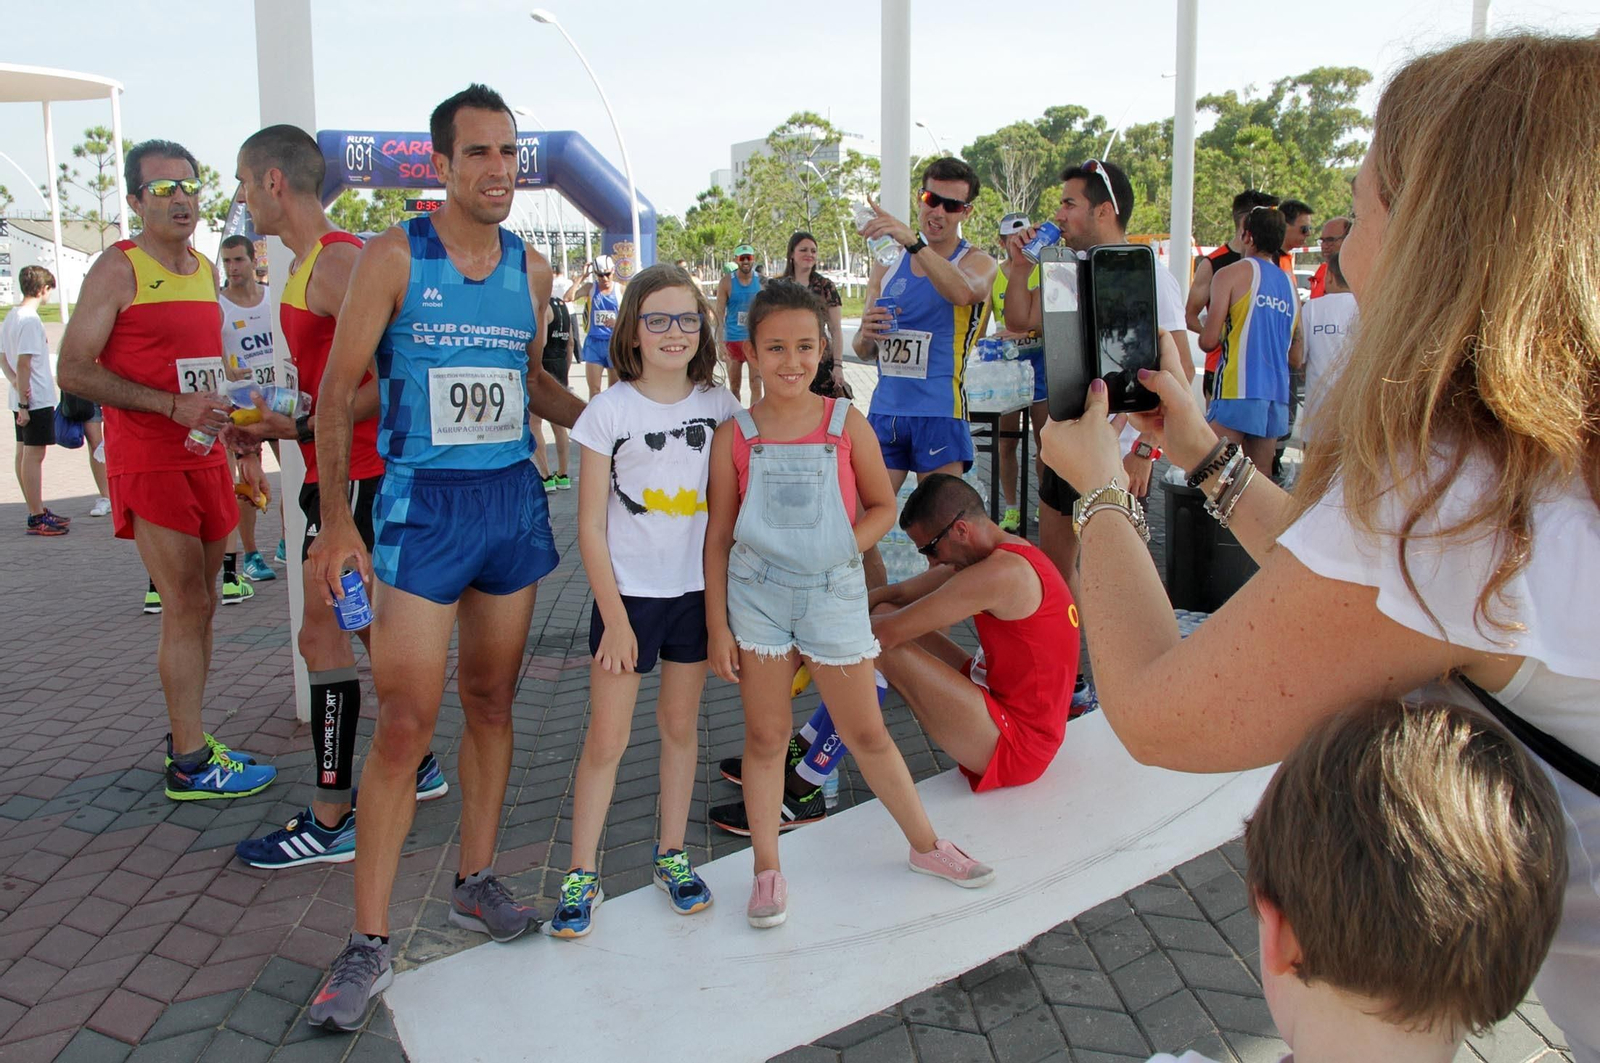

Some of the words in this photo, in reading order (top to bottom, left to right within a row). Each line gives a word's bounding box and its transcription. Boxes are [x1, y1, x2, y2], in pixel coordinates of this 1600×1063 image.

[347, 135, 375, 145] RUTA
[346, 144, 373, 171] 091
[412, 322, 457, 333] CLUB
[459, 324, 532, 340] ONUBENSE
[412, 334, 436, 345] DE
[882, 338, 922, 365] 3251
[450, 382, 505, 423] 999
